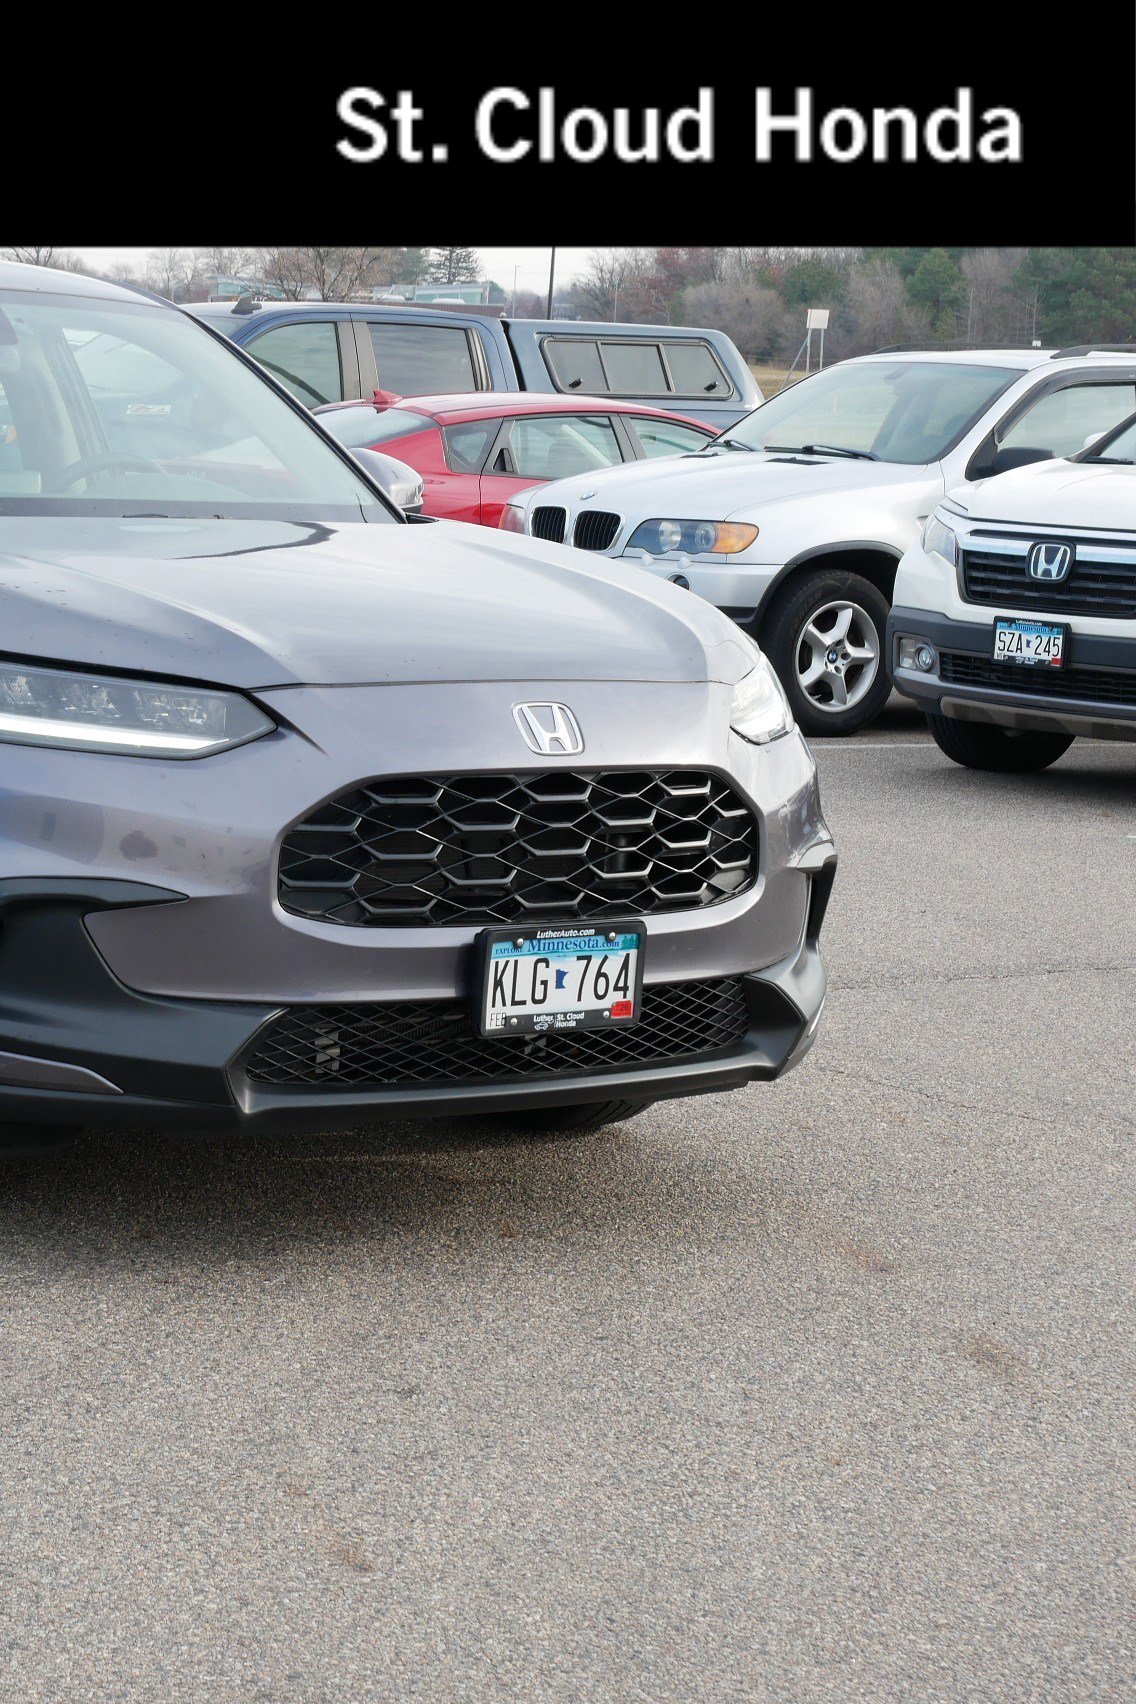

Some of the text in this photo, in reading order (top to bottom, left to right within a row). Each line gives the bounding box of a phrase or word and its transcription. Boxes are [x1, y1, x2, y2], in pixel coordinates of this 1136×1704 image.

[997, 631, 1061, 657] SZA 245
[536, 928, 596, 939] LutherAuto.com
[491, 952, 631, 1008] KLG 764
